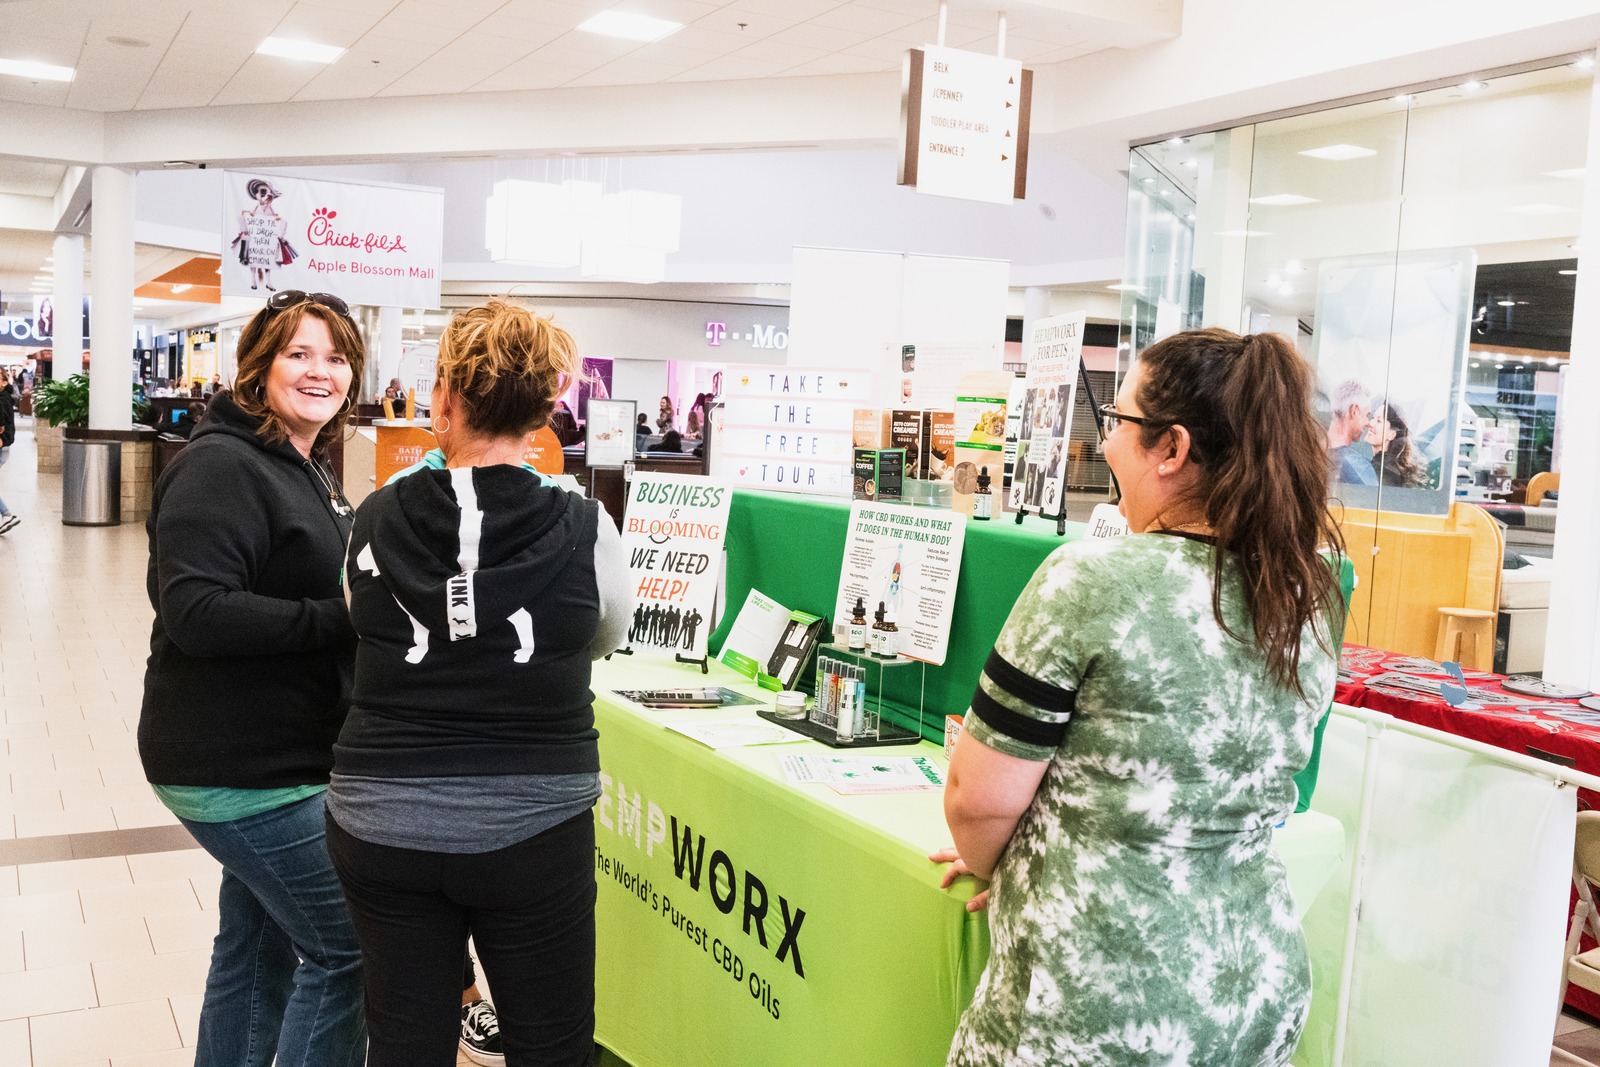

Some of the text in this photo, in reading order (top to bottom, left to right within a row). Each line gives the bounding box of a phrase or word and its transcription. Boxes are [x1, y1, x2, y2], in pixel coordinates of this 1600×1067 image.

[933, 61, 949, 73] BELK
[932, 88, 963, 102] JCPENNEY
[931, 115, 989, 134] TODDLER PLAY AREA
[929, 142, 965, 157] ENTRANCE 2
[246, 217, 265, 227] SHOP
[253, 236, 270, 246] THEN
[307, 215, 408, 254] Chick-fil-A
[307, 258, 435, 280] Apple Blossom Mall
[752, 324, 789, 350] Mo
[1033, 322, 1077, 344] HEMPWORX
[1037, 342, 1068, 360] FOR PETS
[769, 374, 824, 394] TAKE
[774, 405, 812, 424] THE
[892, 426, 919, 434] CREAMER
[398, 447, 423, 455] BATH
[765, 434, 818, 455] FREE
[762, 464, 816, 486] TOUR
[855, 462, 874, 471] COFFEE
[636, 482, 725, 509] BUSINESS
[669, 508, 680, 519] IS
[859, 509, 952, 532] HOW CBD WORKS AND WHAT
[627, 517, 720, 541] BLOOMING
[855, 522, 952, 546] IT DOES IN THE HUMAN BODY
[1092, 518, 1121, 539] Have
[629, 547, 710, 575] WE NEED
[636, 576, 690, 602] HELP!
[599, 770, 807, 980] EMPWORX
[595, 846, 781, 1021] he World's Purest CBD Oils
